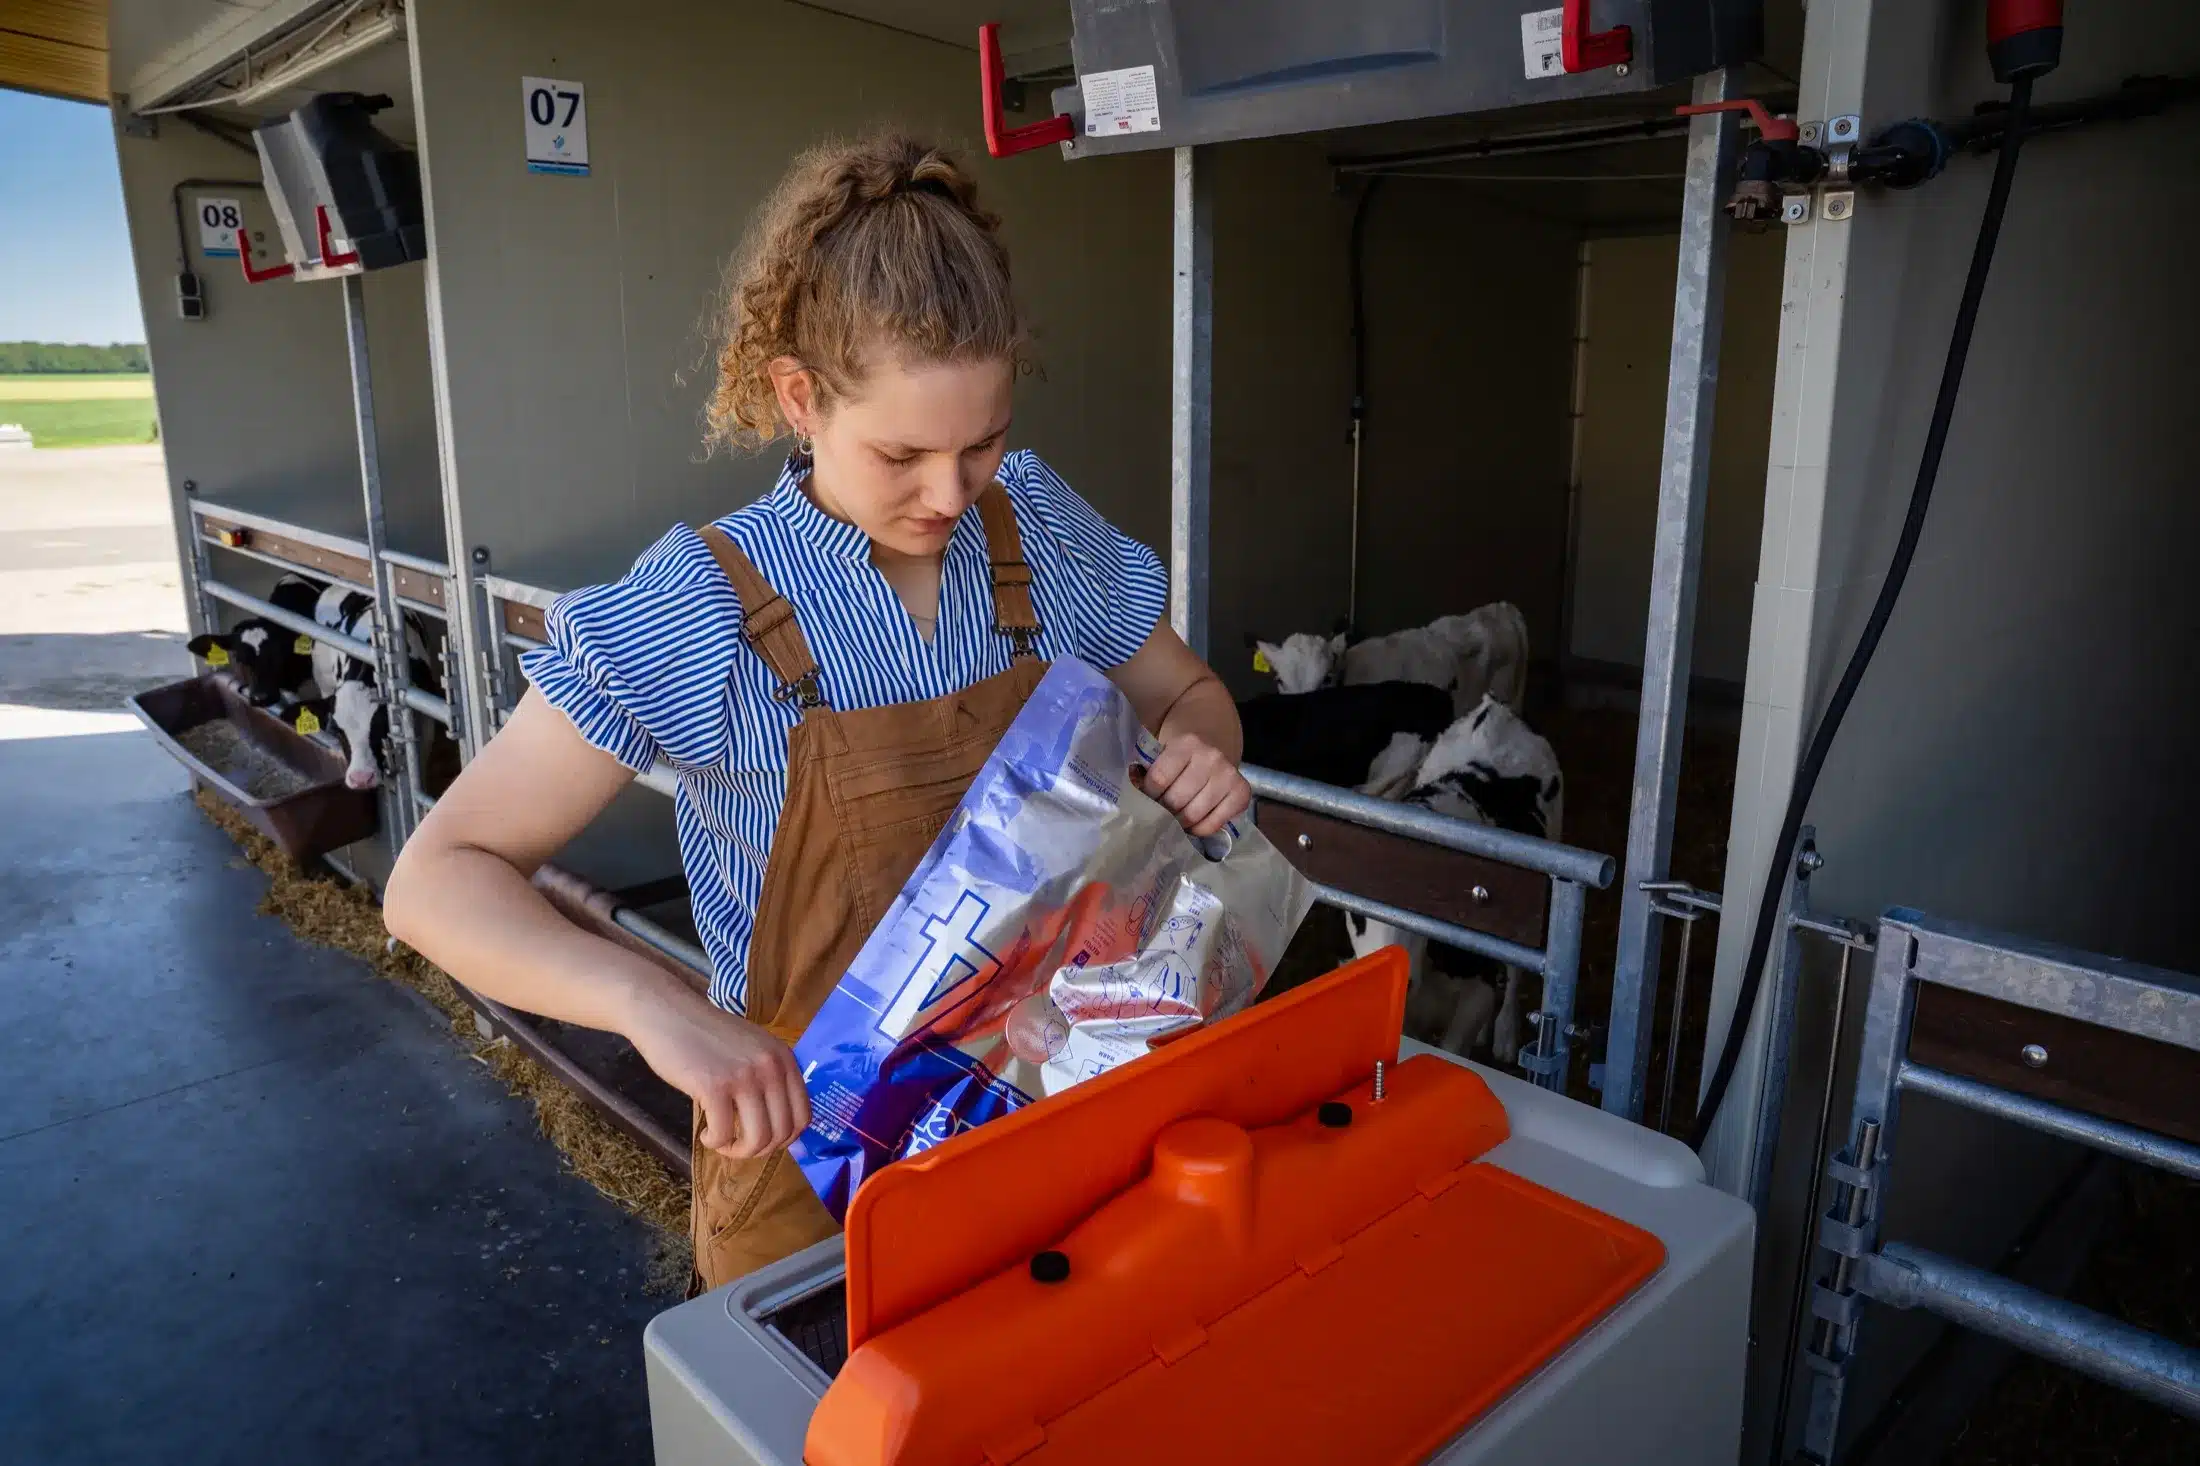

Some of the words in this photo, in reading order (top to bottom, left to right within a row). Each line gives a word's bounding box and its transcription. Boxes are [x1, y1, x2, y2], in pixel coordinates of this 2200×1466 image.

[530, 88, 580, 128] 07
[203, 205, 239, 228] 08
[1067, 761, 1119, 804] DairyTechInc.com
[874, 889, 1004, 1045] 4
